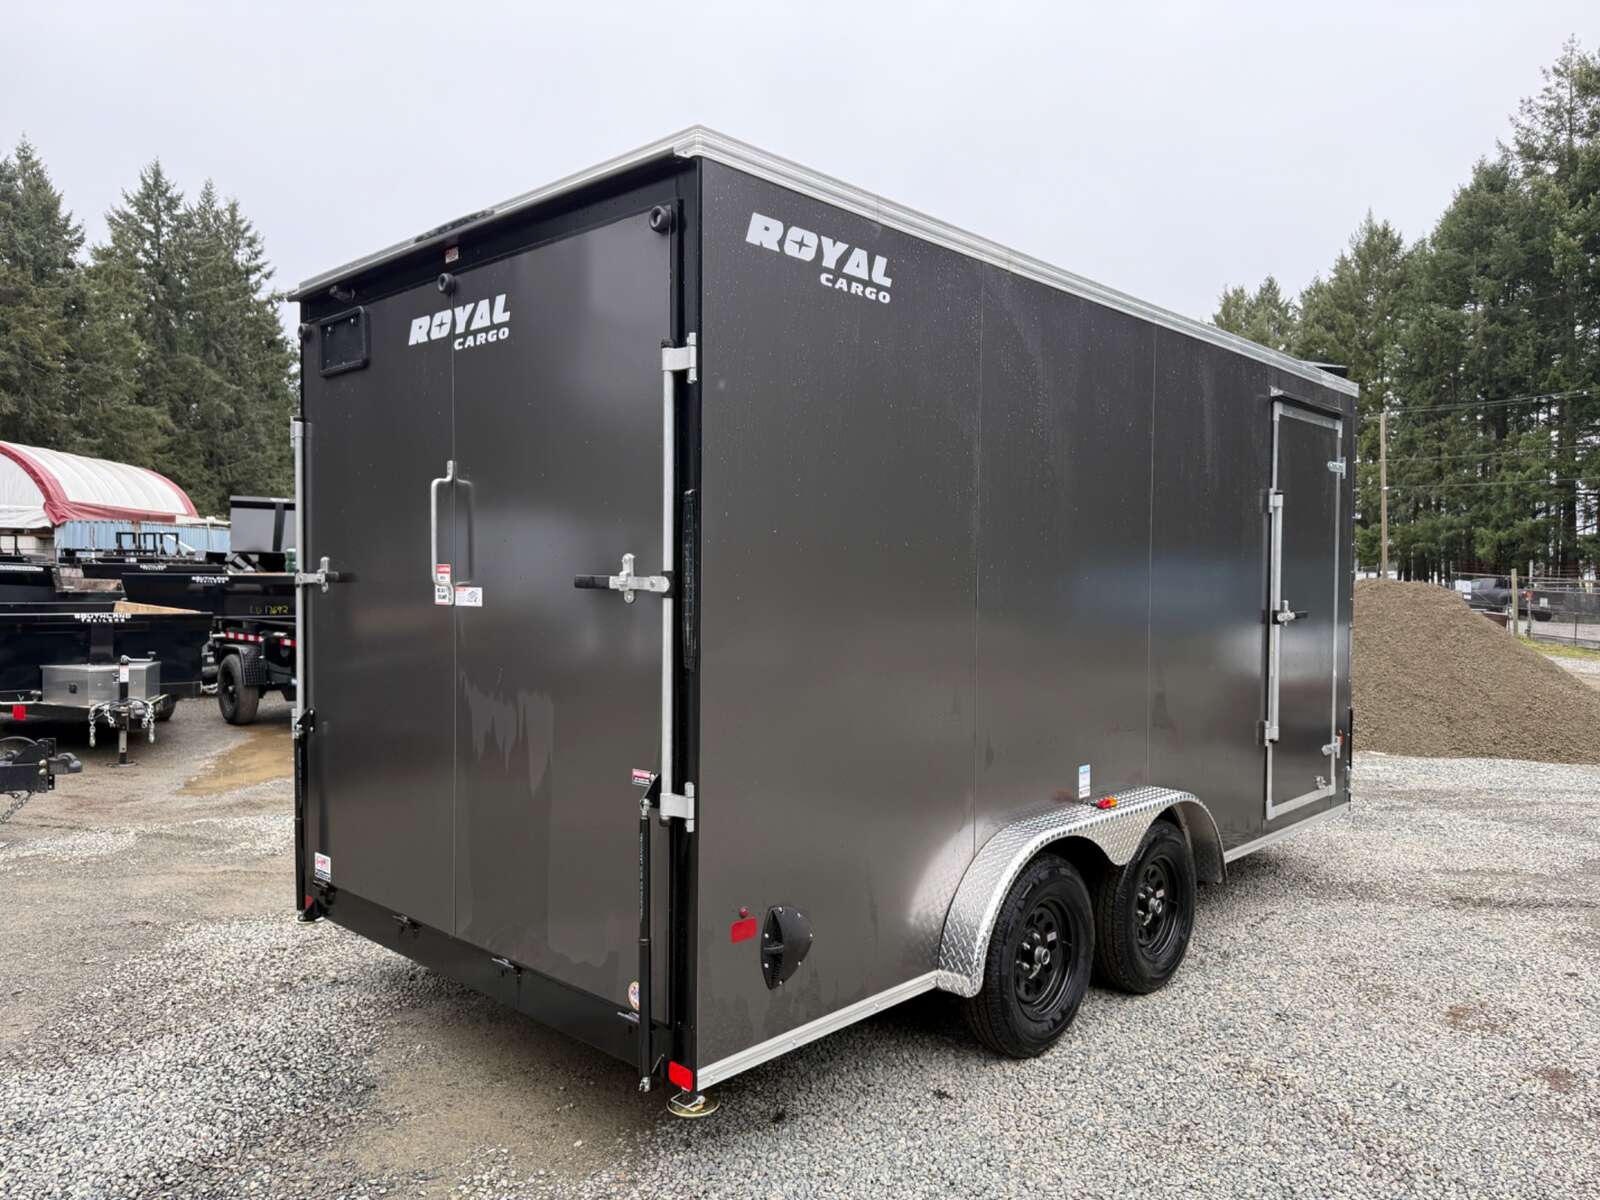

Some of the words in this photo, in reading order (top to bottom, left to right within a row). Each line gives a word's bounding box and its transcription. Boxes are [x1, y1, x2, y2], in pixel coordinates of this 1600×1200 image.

[745, 212, 893, 288] ROYAL
[819, 272, 891, 304] CARGO
[408, 293, 511, 346] ROYAL
[453, 327, 510, 351] CARGO
